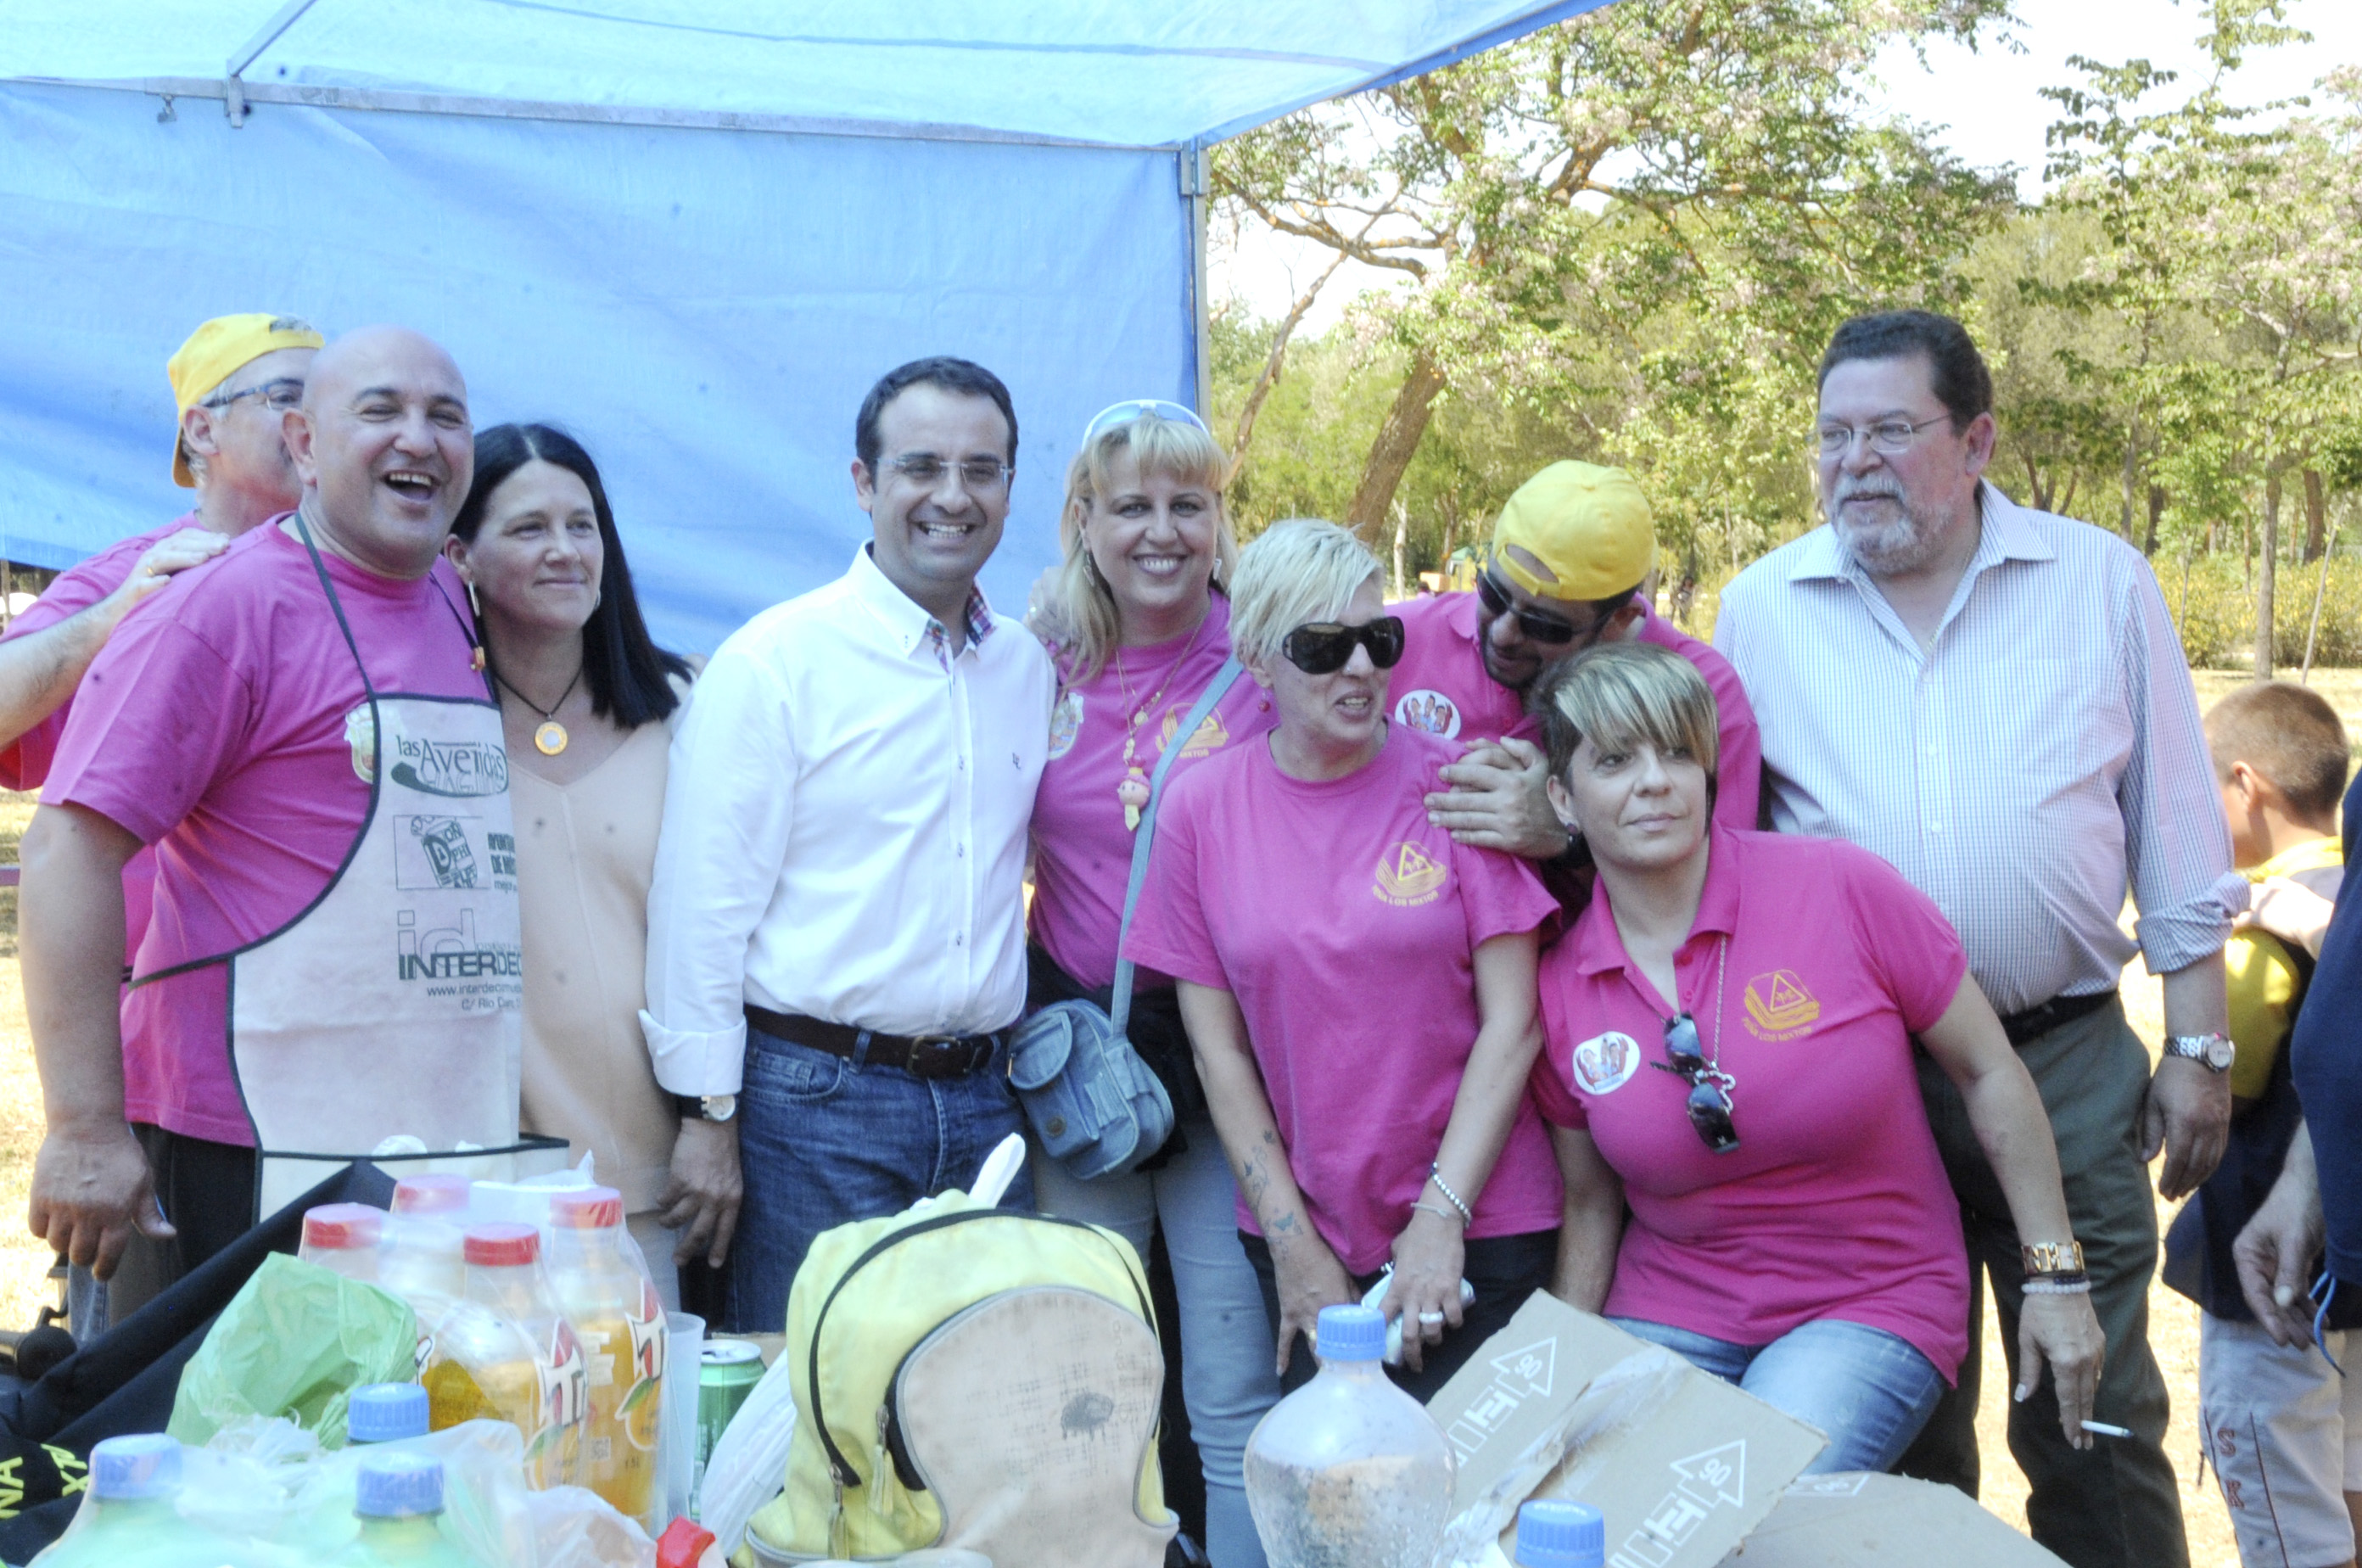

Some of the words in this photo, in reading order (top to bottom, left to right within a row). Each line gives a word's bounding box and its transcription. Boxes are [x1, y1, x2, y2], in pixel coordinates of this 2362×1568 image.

[396, 735, 421, 757] las
[1514, 1352, 1543, 1380] 90
[1698, 1457, 1732, 1487] 90
